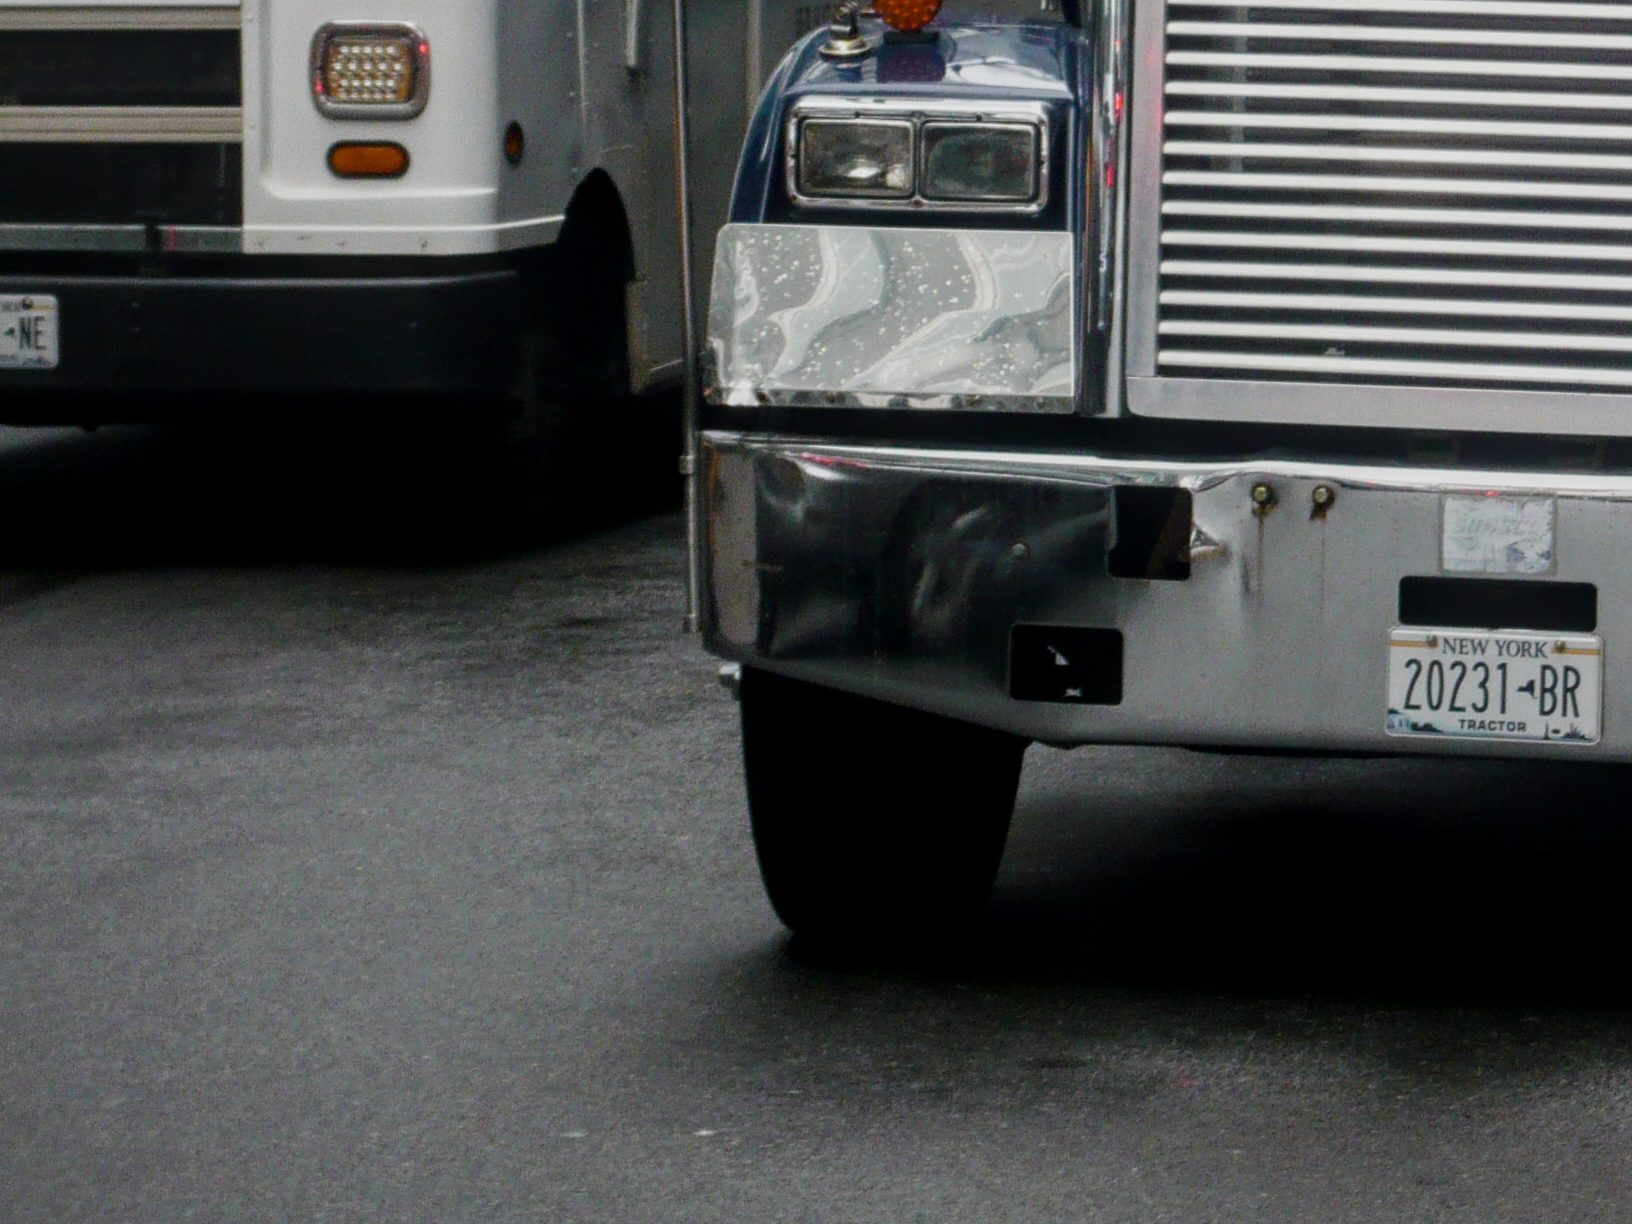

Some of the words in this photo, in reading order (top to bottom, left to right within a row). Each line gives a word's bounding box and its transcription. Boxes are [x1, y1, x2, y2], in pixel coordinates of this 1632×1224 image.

[1442, 638, 1494, 656] NEW
[1494, 640, 1548, 659] YORK
[1403, 658, 1508, 715] 20231
[1539, 664, 1582, 719] BR
[1458, 719, 1527, 733] TRACTOR
